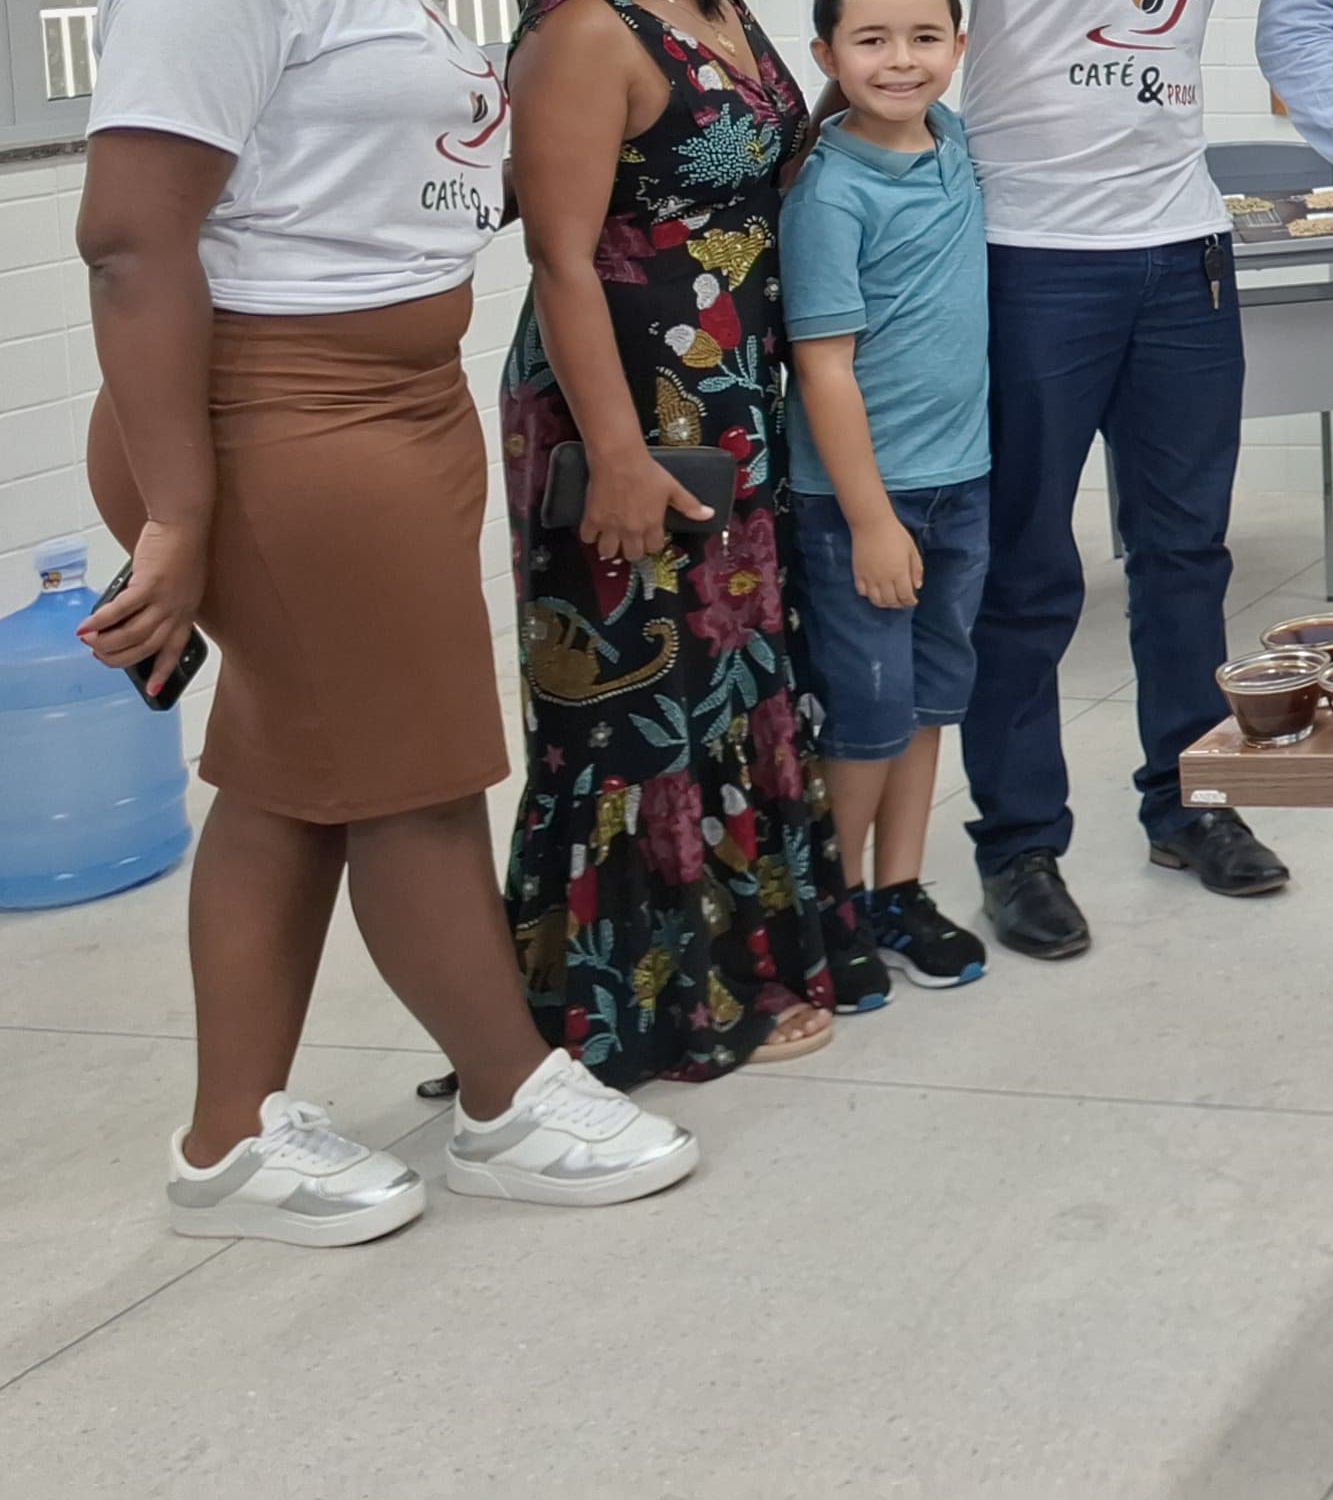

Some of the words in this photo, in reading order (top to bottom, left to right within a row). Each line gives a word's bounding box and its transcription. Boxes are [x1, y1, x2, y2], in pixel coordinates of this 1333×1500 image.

[1069, 55, 1135, 87] CAFÉ
[1137, 66, 1164, 106] &
[421, 172, 471, 211] CAFÉ
